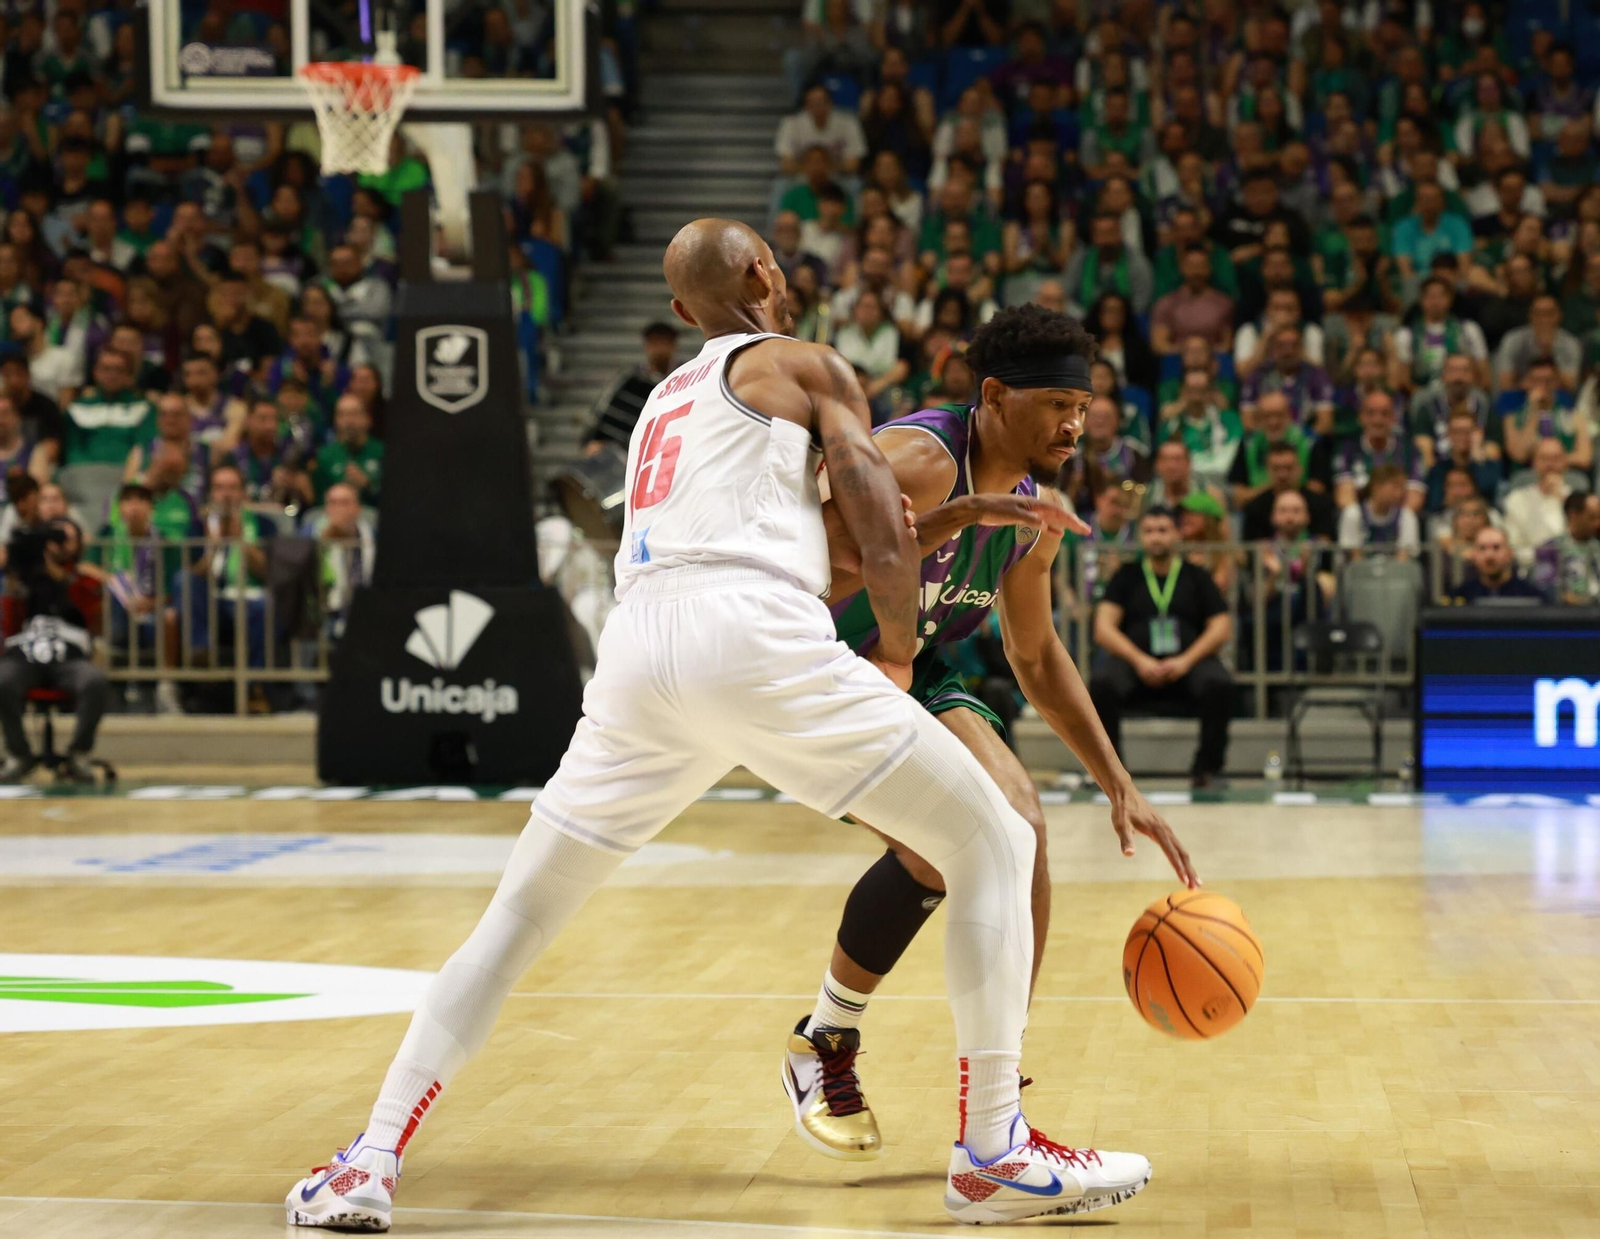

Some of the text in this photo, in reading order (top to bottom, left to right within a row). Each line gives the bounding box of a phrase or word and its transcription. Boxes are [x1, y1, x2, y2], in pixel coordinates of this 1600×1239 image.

[656, 356, 720, 399] SMITH
[630, 400, 695, 528] 15
[380, 677, 519, 723] Unicaja
